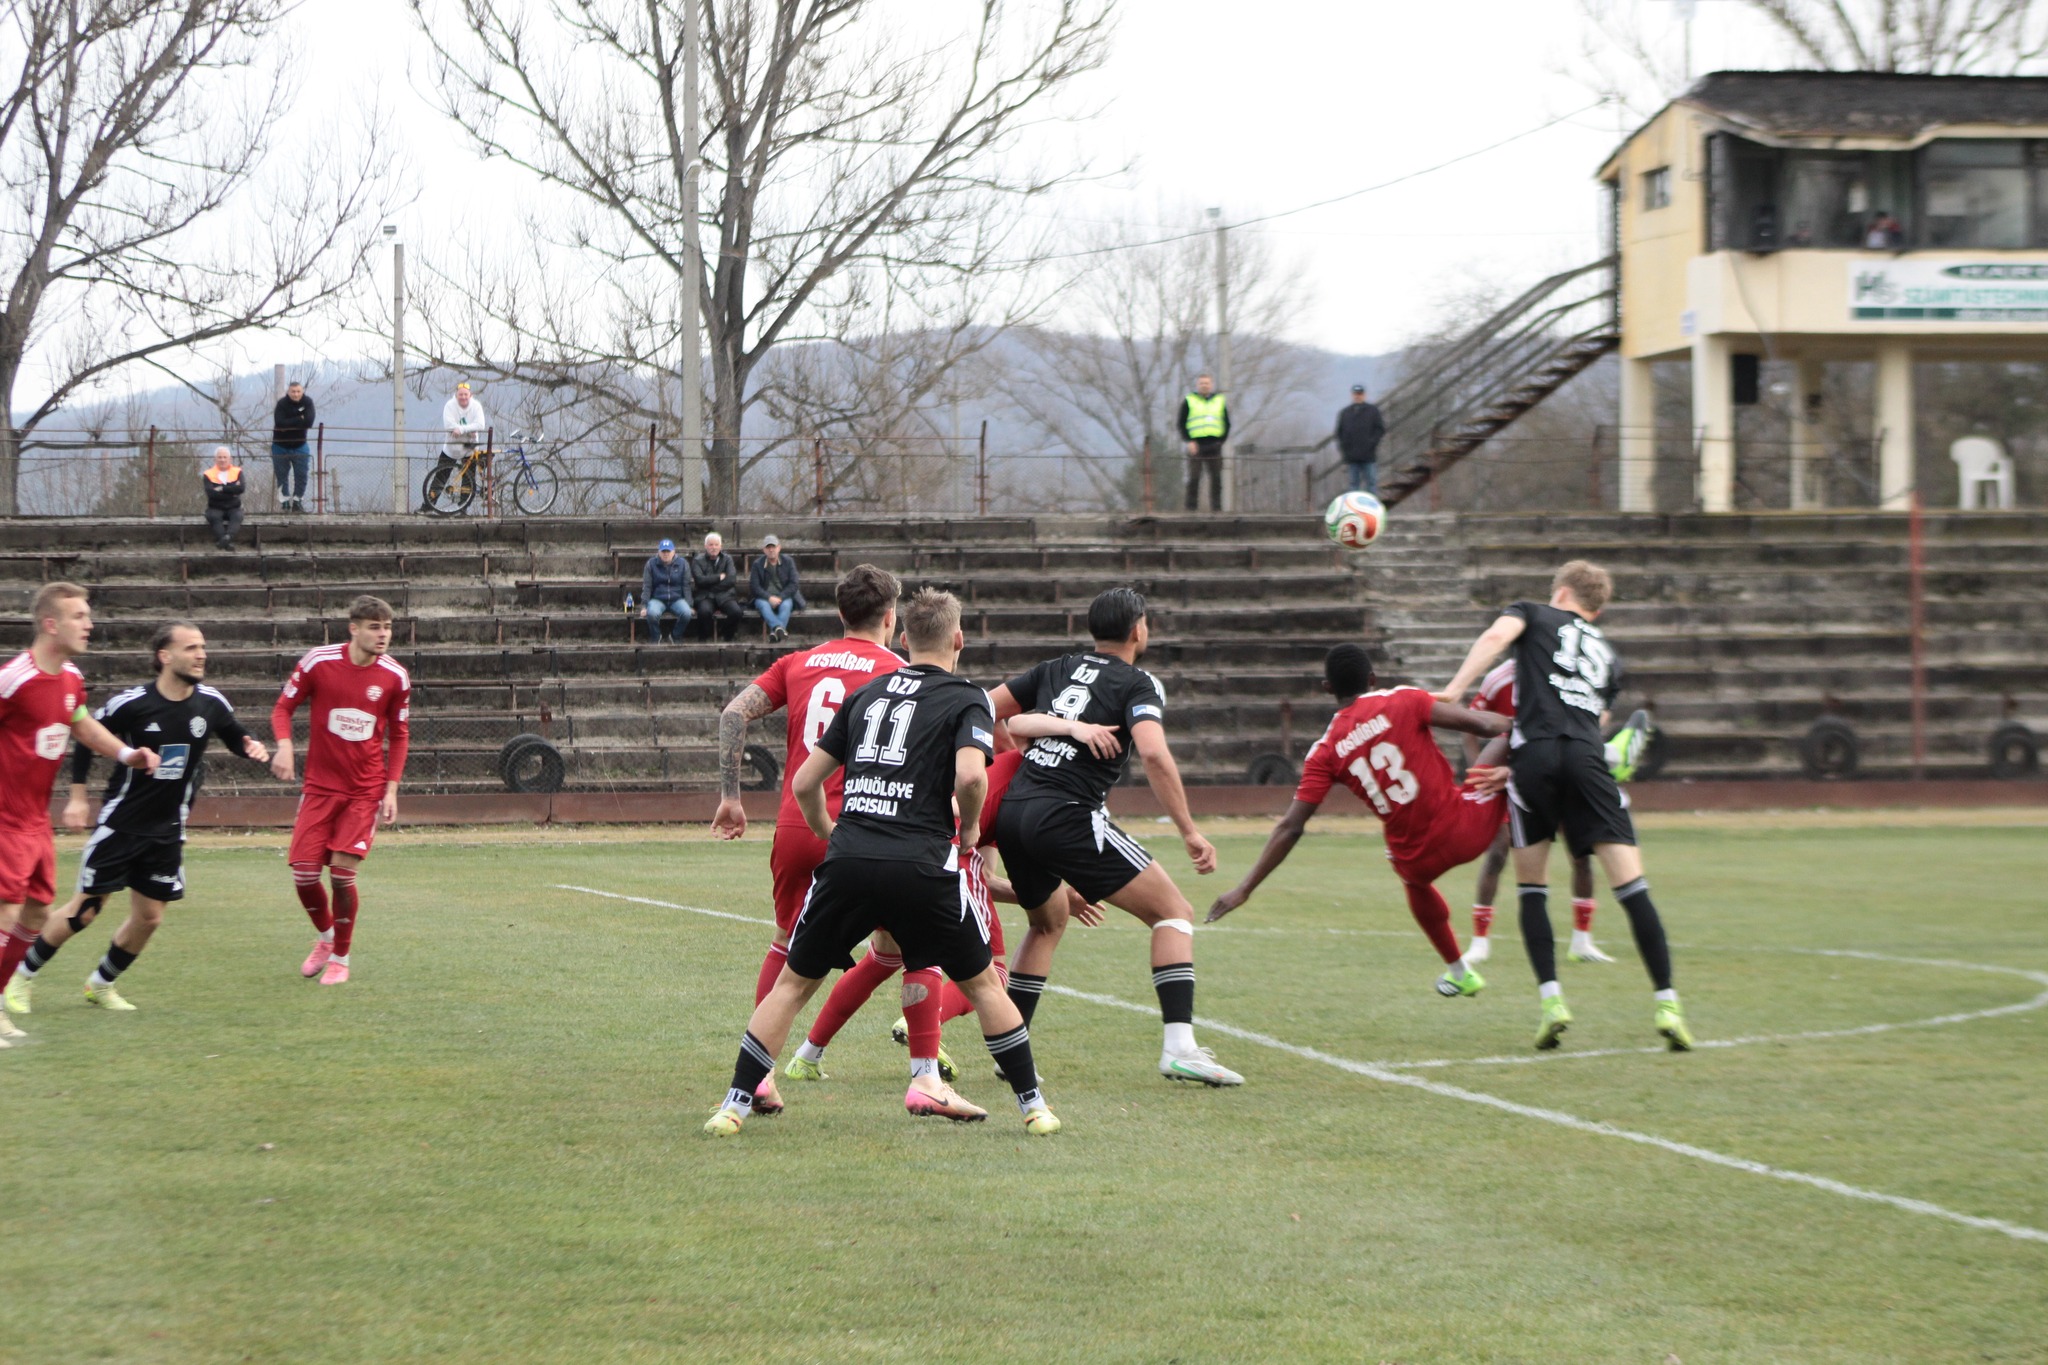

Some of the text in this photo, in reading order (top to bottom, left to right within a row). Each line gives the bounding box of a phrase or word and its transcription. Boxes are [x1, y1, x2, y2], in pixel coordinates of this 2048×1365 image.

[805, 651, 876, 673] KISVÁRDA
[1553, 624, 1616, 688] 15
[803, 677, 846, 754] 6
[855, 698, 917, 766] 11
[1051, 685, 1092, 722] 9
[1348, 741, 1420, 815] 13
